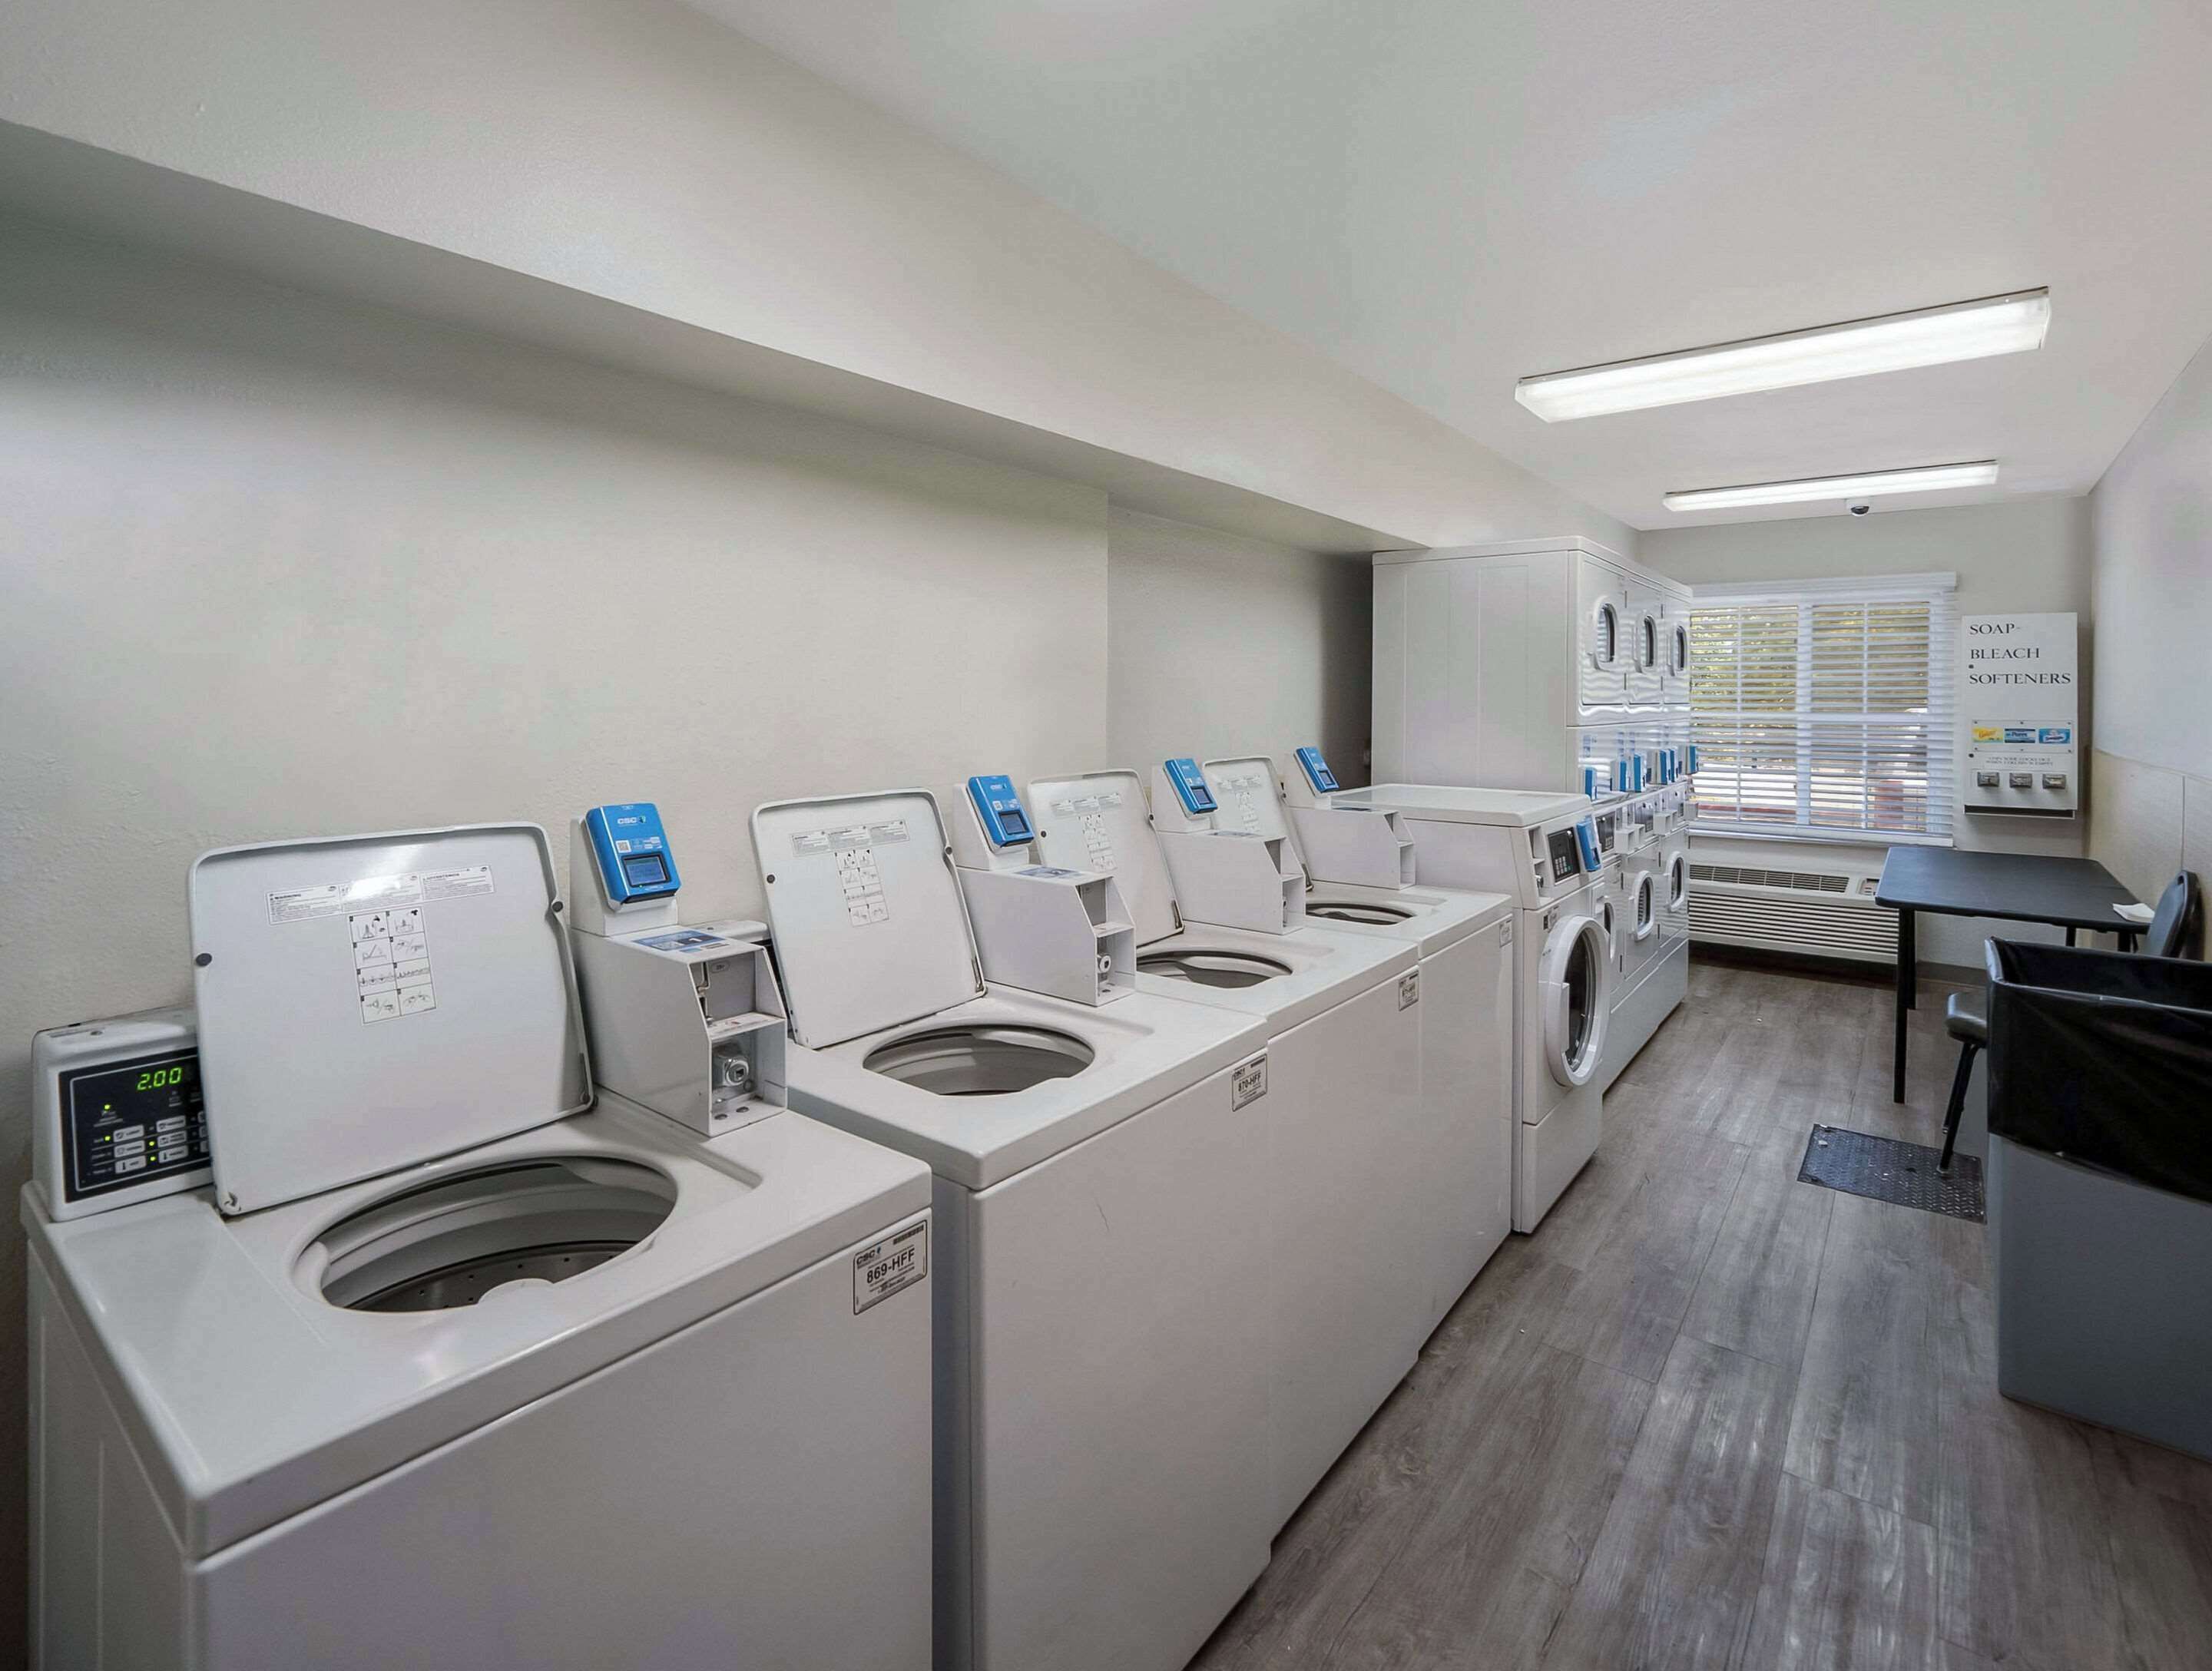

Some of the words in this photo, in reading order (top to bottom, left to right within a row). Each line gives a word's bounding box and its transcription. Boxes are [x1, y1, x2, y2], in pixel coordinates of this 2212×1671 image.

[1970, 648, 2039, 659] BLEACH
[1969, 673, 2071, 684] SOFTENERS
[137, 1067, 182, 1090] 2.00
[867, 1248, 915, 1283] 869-HFF
